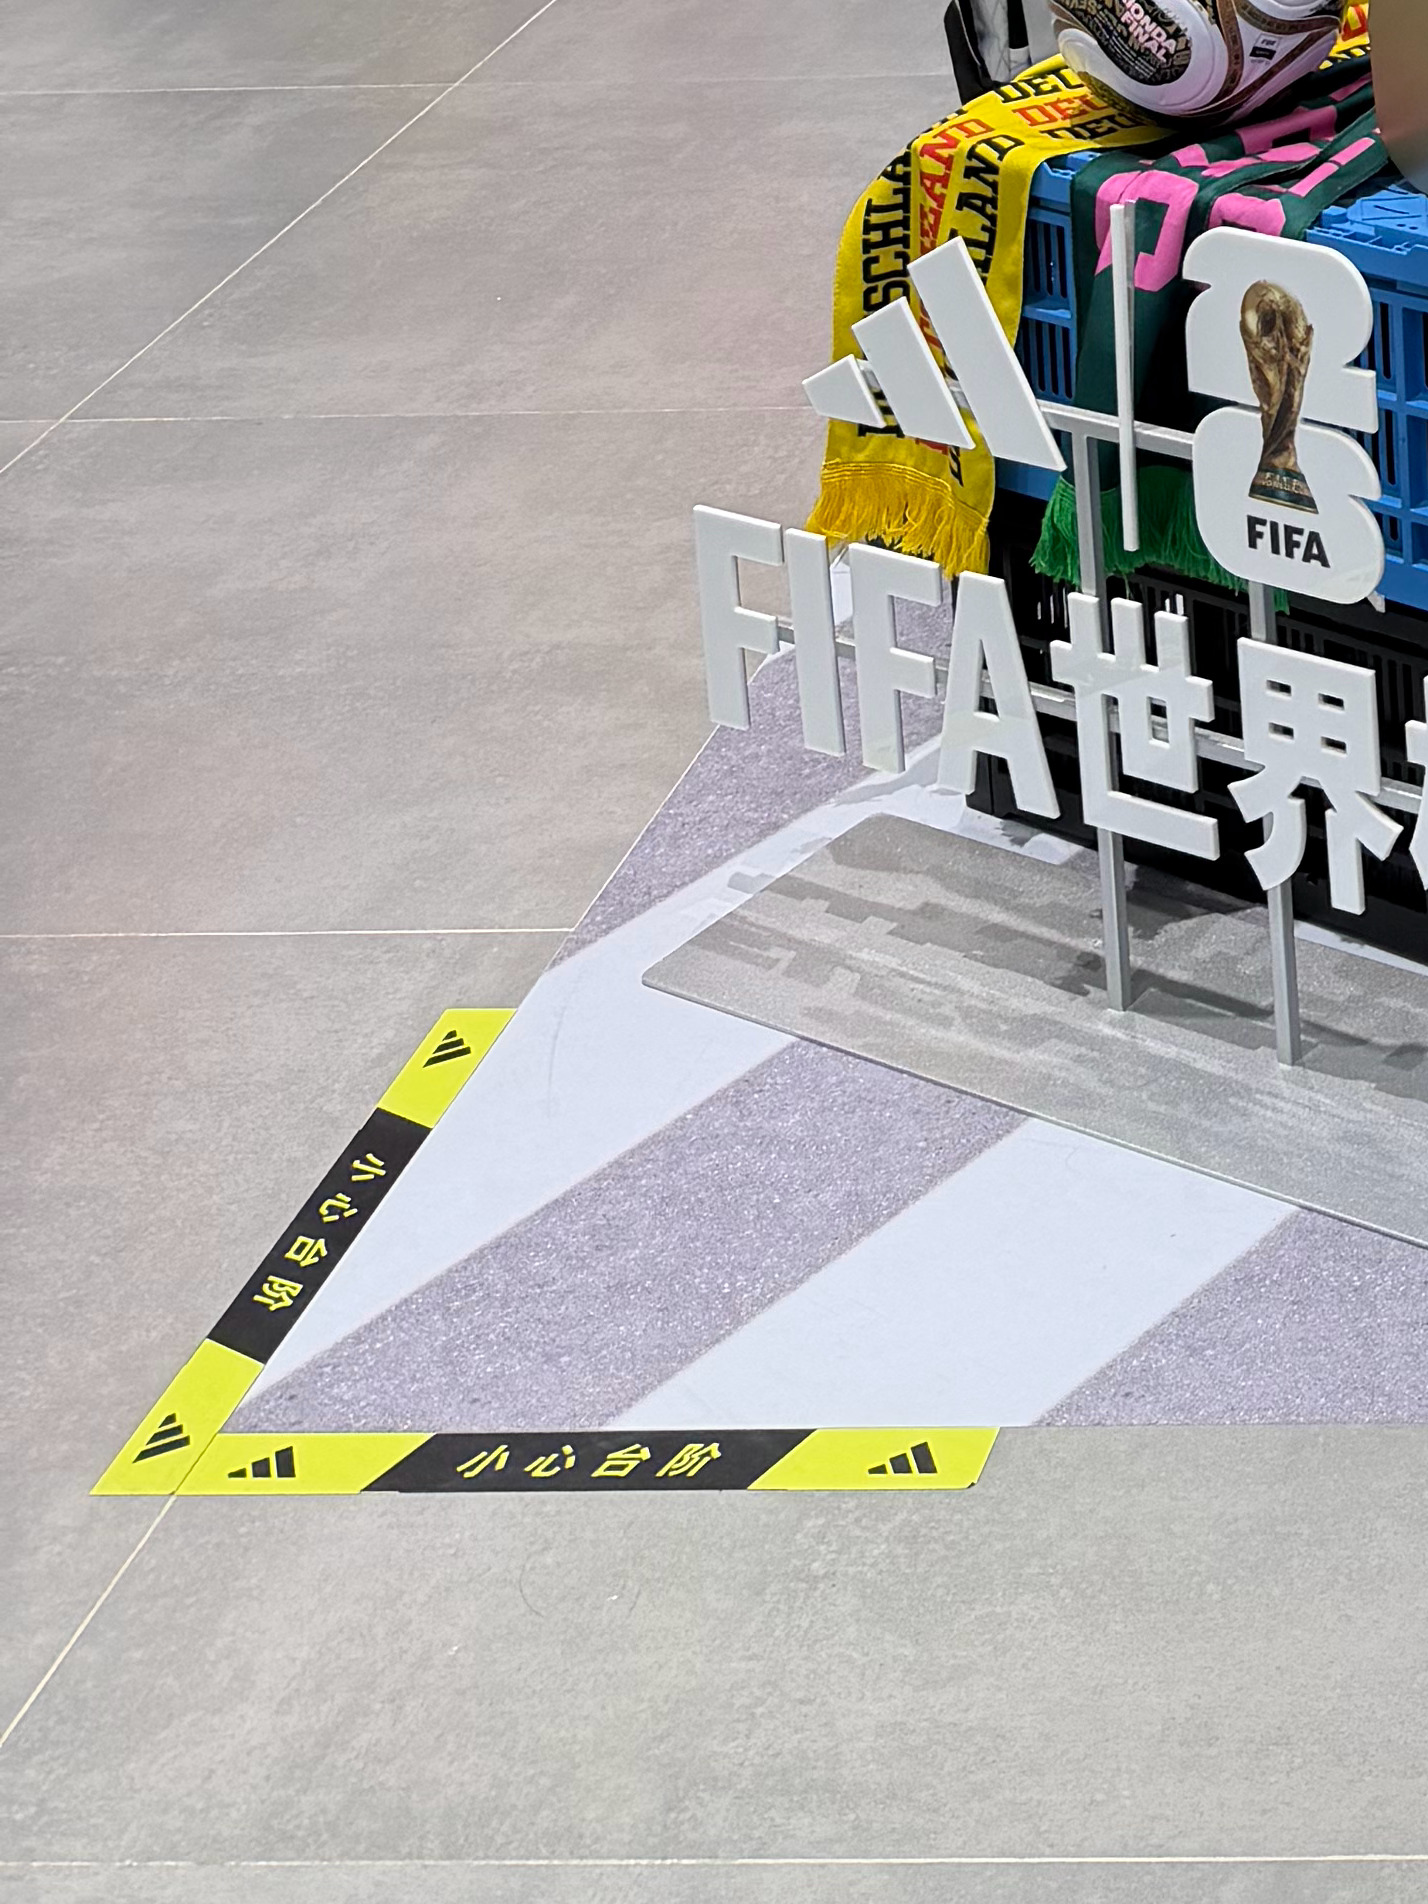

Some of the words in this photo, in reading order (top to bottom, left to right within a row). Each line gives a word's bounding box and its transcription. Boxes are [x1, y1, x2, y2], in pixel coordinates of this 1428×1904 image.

[1119, 9, 1168, 63] FINAL
[1246, 514, 1332, 569] FIFA
[252, 1150, 387, 1314] 小心台阶
[456, 1441, 723, 1481] 小心台阶
